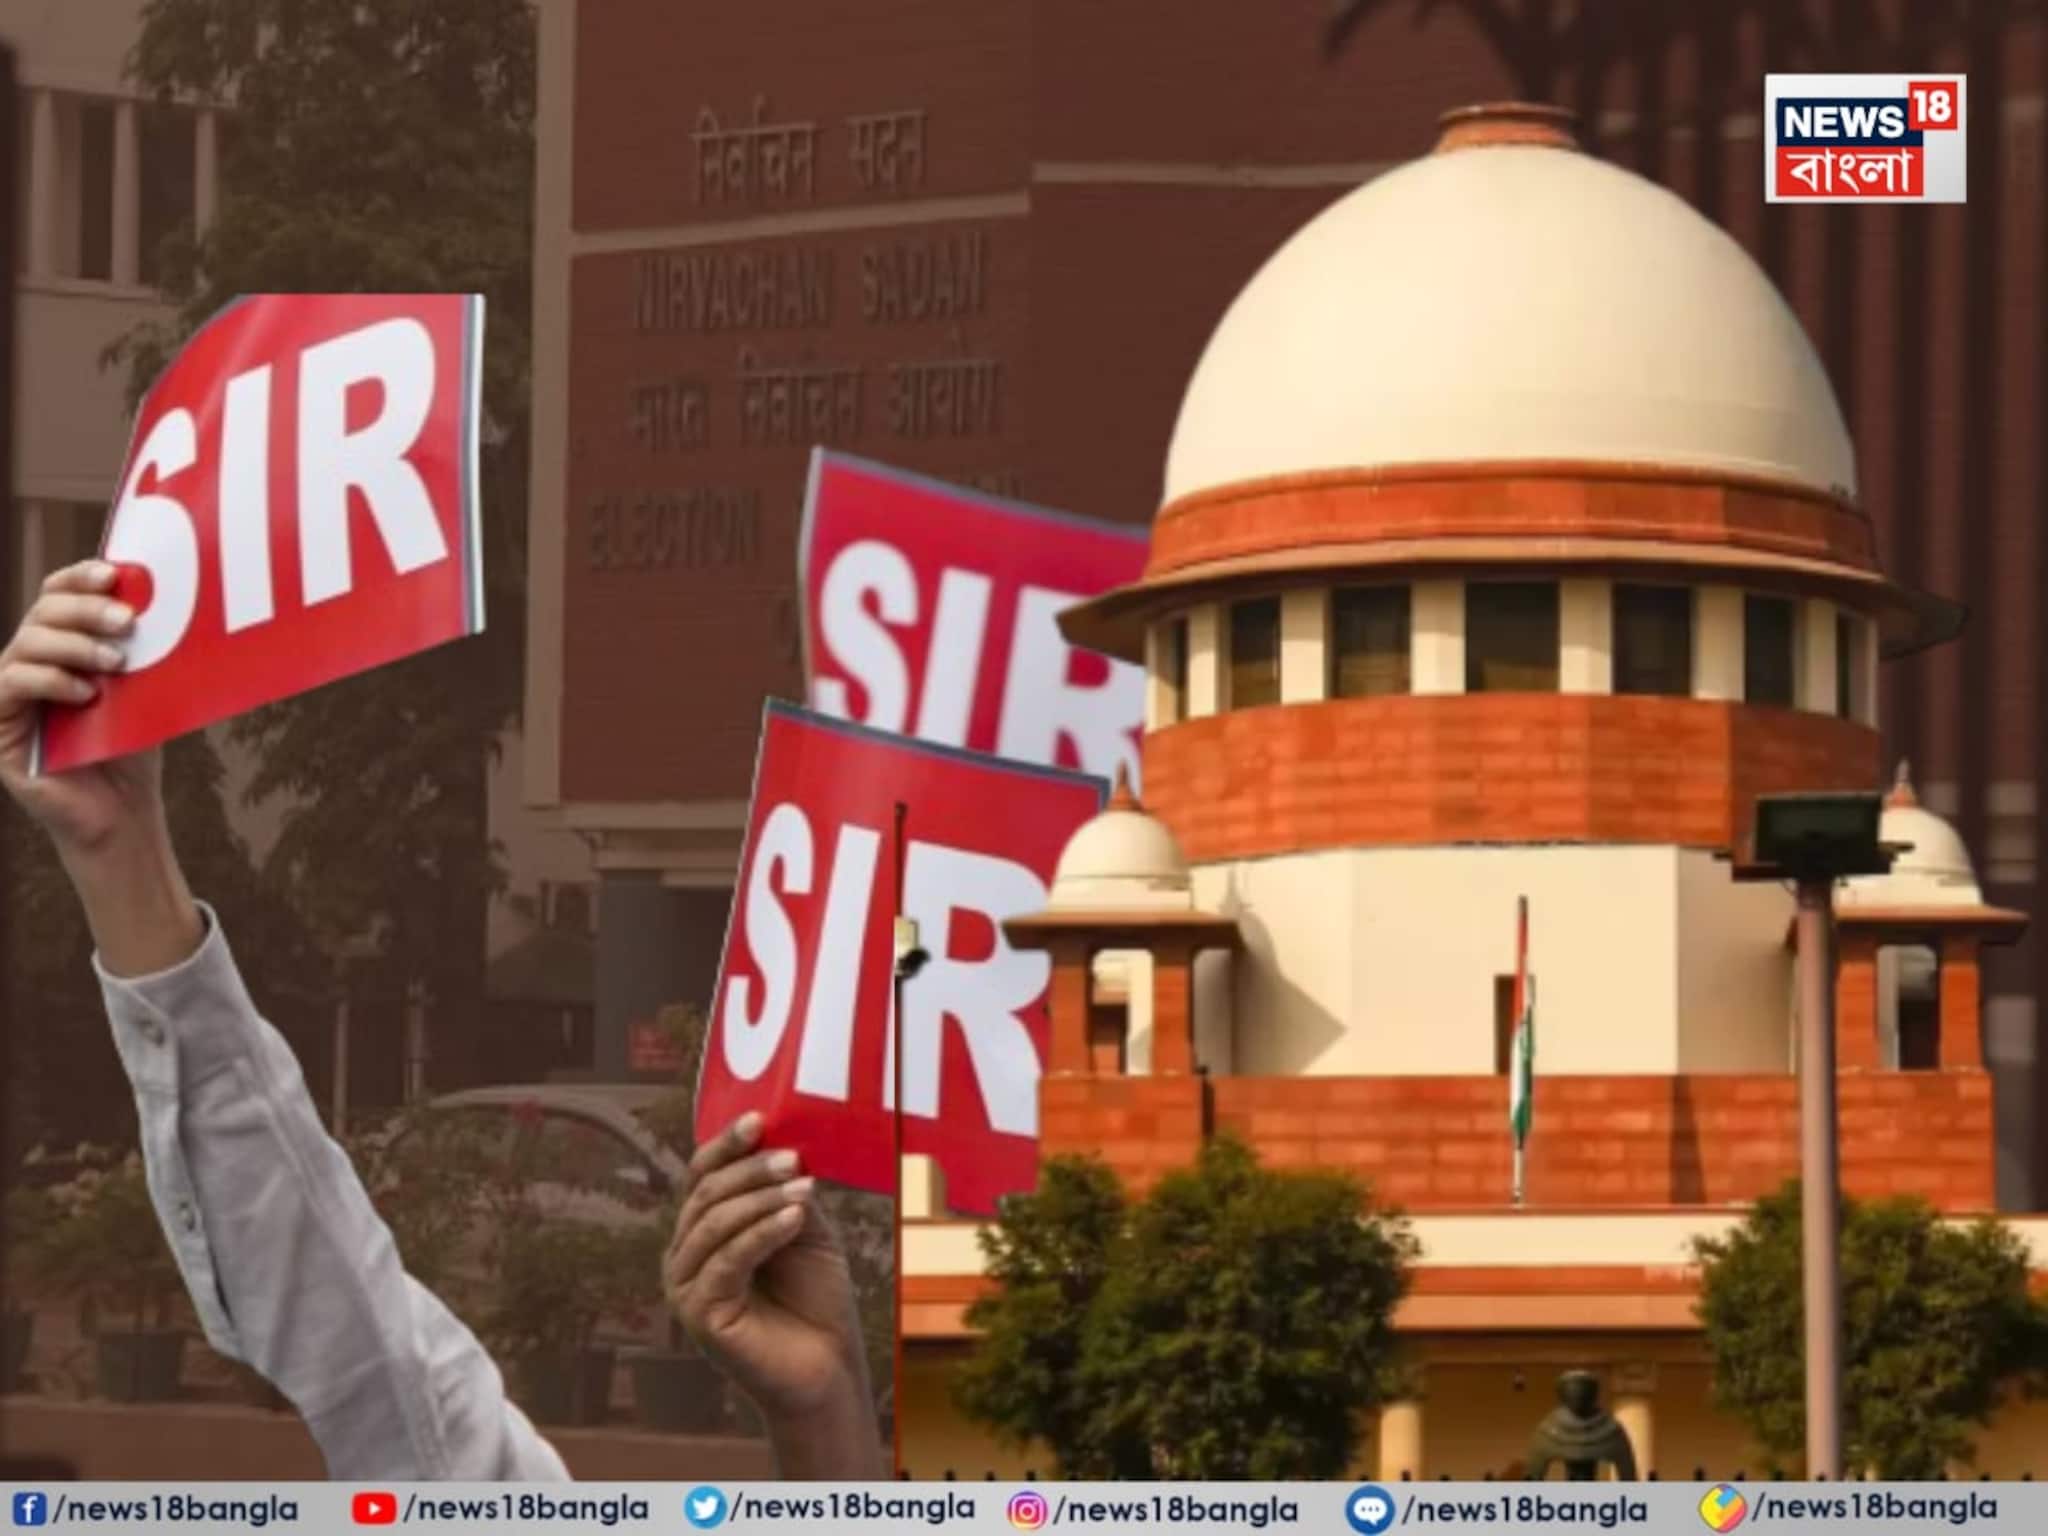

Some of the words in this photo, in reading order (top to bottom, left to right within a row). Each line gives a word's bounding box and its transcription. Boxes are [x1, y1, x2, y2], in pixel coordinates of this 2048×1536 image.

[690, 95, 821, 206] निर्वाचन
[847, 108, 928, 192] सदन
[863, 231, 991, 323] SADAN
[103, 315, 449, 673] SIR
[589, 487, 761, 573] ELECTION
[722, 801, 1053, 1139] SIR
